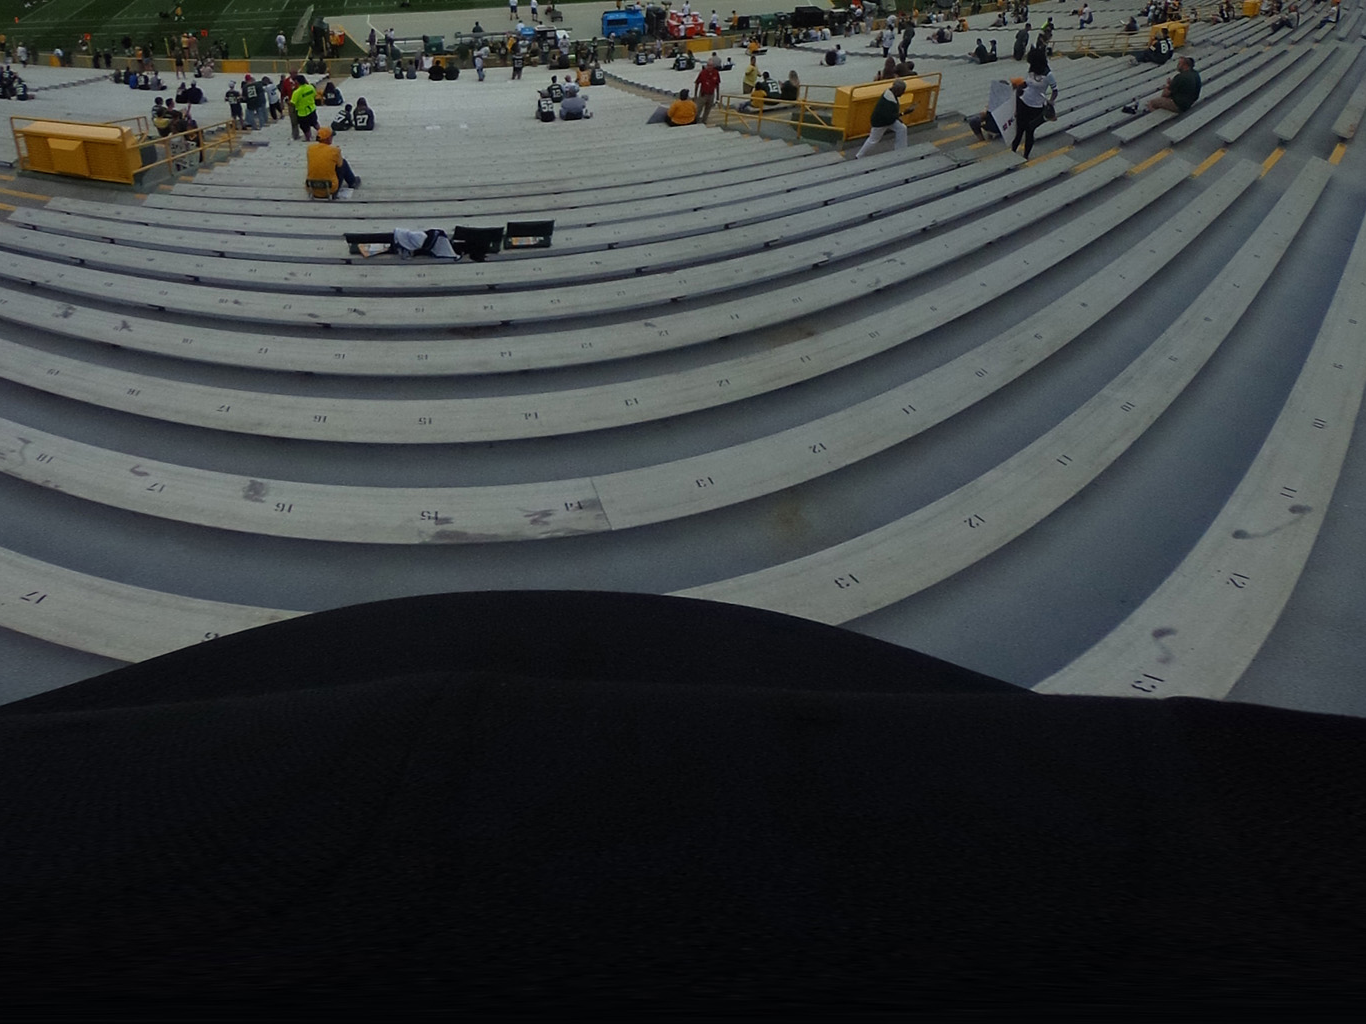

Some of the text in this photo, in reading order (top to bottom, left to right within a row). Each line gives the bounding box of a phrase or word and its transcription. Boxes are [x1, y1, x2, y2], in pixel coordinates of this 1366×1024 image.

[247, 86, 258, 98] 21
[767, 83, 778, 93] 12
[552, 89, 562, 98] 12
[541, 101, 553, 112] 52
[356, 114, 369, 126] 27
[800, 355, 811, 363] 11
[975, 368, 988, 377] 10
[717, 379, 730, 387] 12
[625, 398, 638, 406] 13
[1120, 402, 1135, 412] 10
[902, 405, 916, 414] 11
[418, 417, 432, 425] 15
[524, 412, 538, 420] 14
[1312, 418, 1326, 429] 10
[809, 443, 826, 453] 12
[36, 453, 54, 463] 18
[1056, 455, 1072, 466] 11
[696, 477, 714, 487] 13
[146, 483, 165, 492] 17
[1280, 486, 1297, 498] 11
[275, 503, 293, 513] 16
[564, 501, 583, 511] 14
[421, 511, 439, 521] 15
[964, 514, 985, 528] 12
[834, 574, 859, 589] 13
[1226, 573, 1249, 589] 12
[21, 591, 47, 604] 17
[1131, 674, 1164, 693] 13
